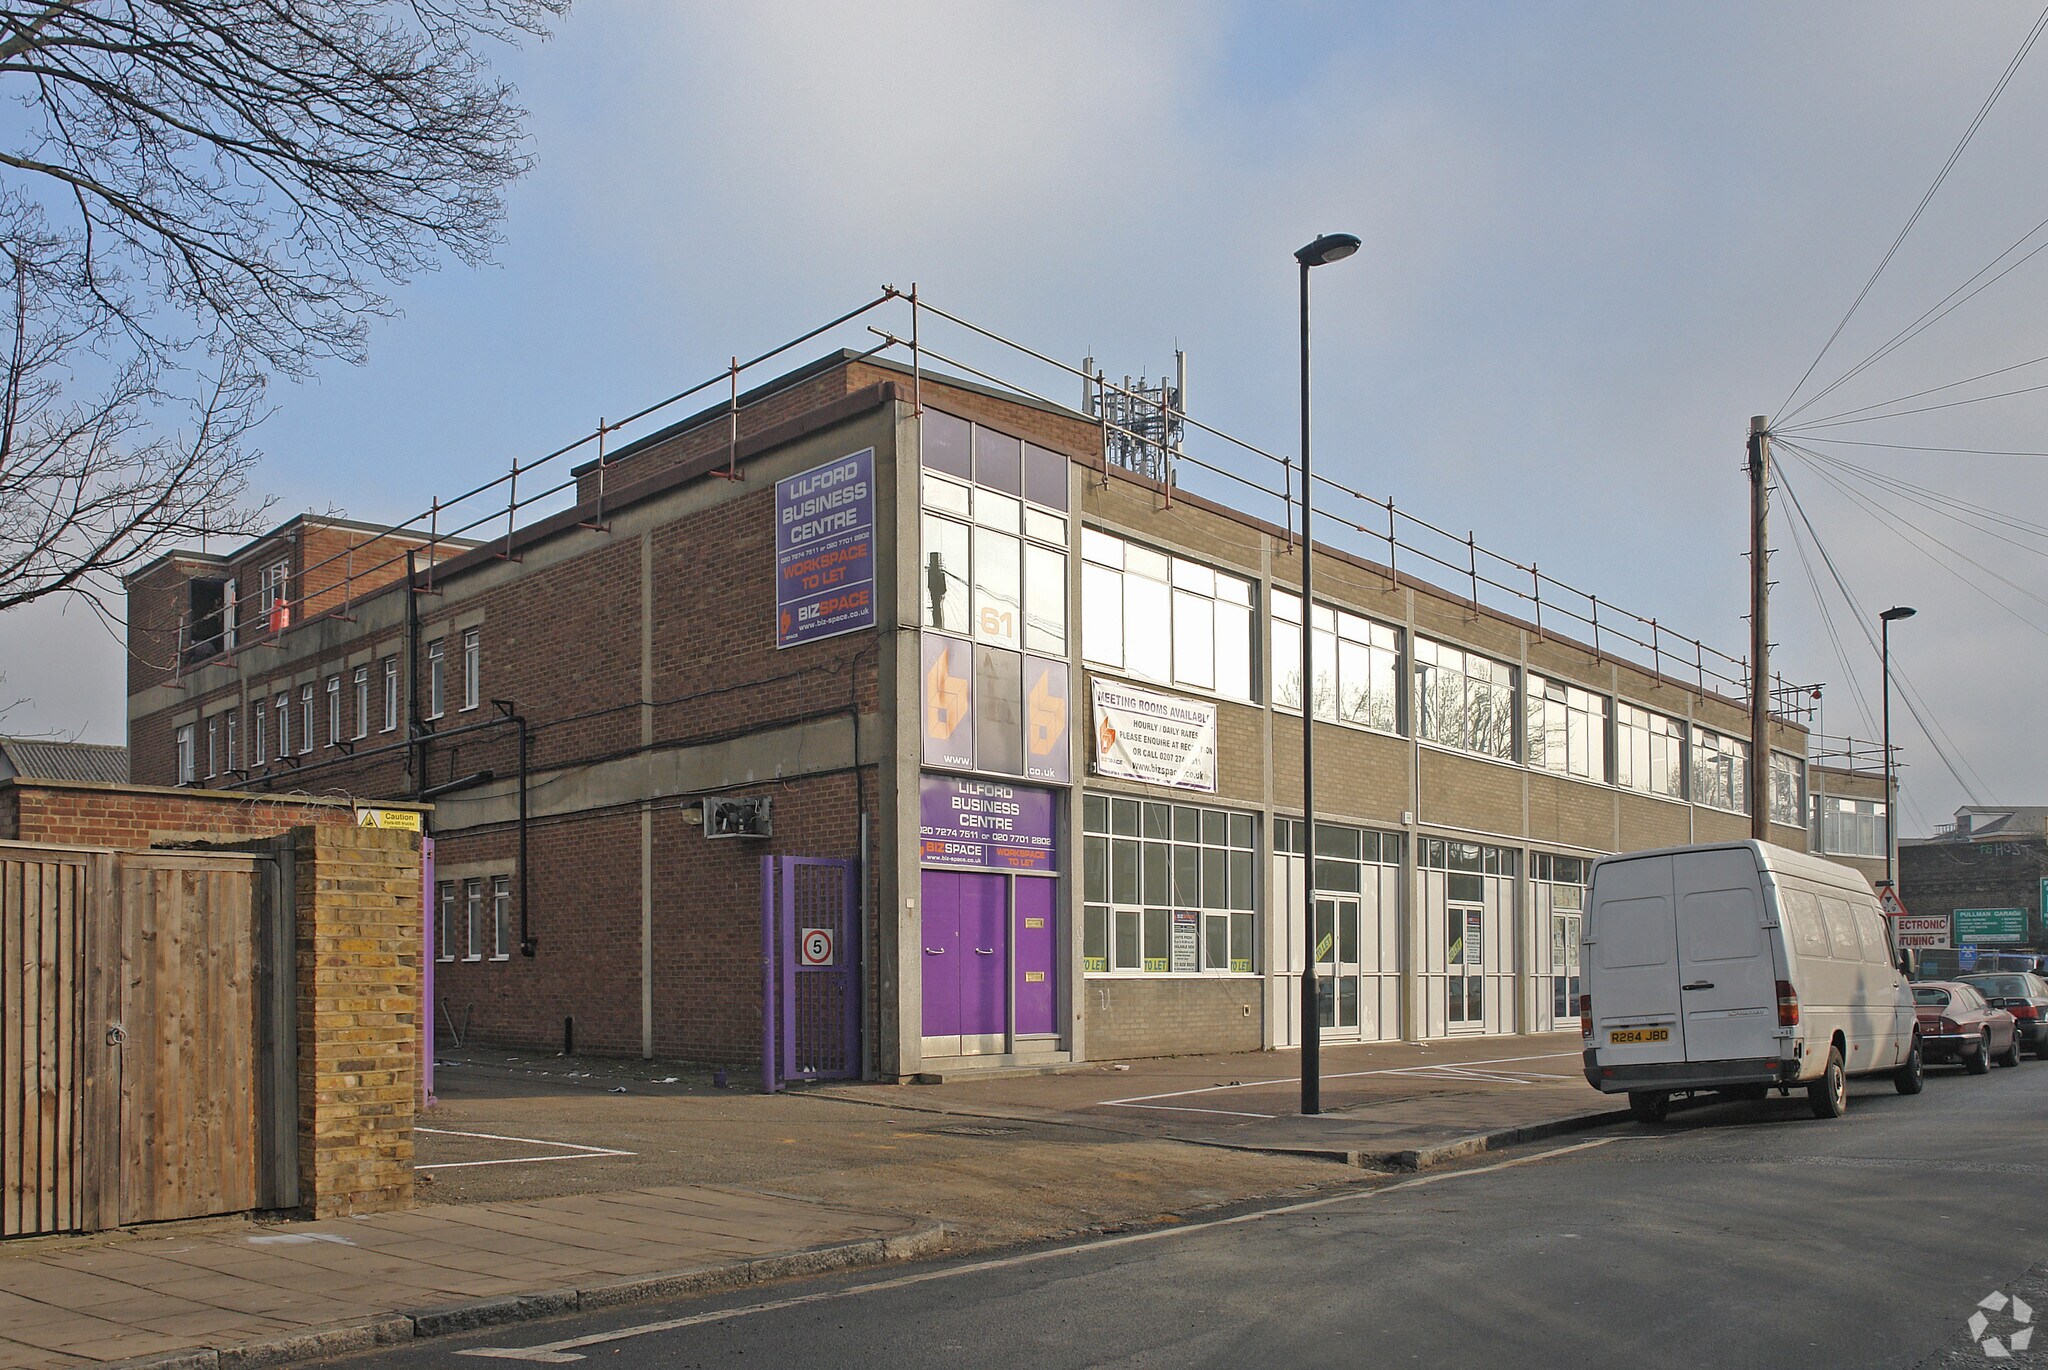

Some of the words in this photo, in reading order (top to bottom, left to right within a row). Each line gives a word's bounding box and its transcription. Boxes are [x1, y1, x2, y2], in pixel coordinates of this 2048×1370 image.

[790, 461, 858, 500] LILFORD
[783, 481, 867, 524] BUSINESS
[790, 508, 857, 544] CENTRE
[805, 547, 819, 555] 7511
[838, 537, 853, 546] 7701
[783, 544, 867, 579] WORKSPACE
[802, 574, 819, 590] TO
[822, 566, 846, 585] LET
[798, 590, 870, 621] BIZSPACE
[798, 607, 870, 631] www.biz-space.co.uk
[980, 606, 1013, 639] 61
[1097, 690, 1136, 709] MEETING
[1139, 700, 1168, 716] ROOMS
[1133, 720, 1158, 732] HOURLY
[1162, 726, 1179, 736] DAILY
[1180, 729, 1199, 740] RATES
[1120, 730, 1142, 743] PLEASE
[1143, 735, 1170, 748] ENQUIRE
[1171, 741, 1179, 750] AT
[1133, 747, 1141, 756] OR
[1142, 750, 1158, 759] CALL
[1159, 752, 1174, 762] 0207
[958, 781, 1013, 799] LILFORD
[952, 797, 1020, 815] BUSINESS
[385, 813, 414, 821] Caution
[959, 814, 1013, 830] CENTRE
[935, 827, 957, 837] 7274
[959, 830, 978, 839] 7511
[992, 833, 1008, 842] 020
[1010, 835, 1029, 843] 7701
[1031, 836, 1051, 845] 2802
[926, 841, 982, 856] BIZSPACE
[996, 847, 1046, 859] WORKSPACE
[926, 855, 981, 863] www.biz-space.co.uk
[1008, 857, 1019, 866] TO
[1021, 859, 1034, 867] LET
[813, 940, 822, 954] 5
[1092, 960, 1105, 971] LET
[1144, 960, 1152, 971] TO
[1154, 960, 1166, 971] LET
[1239, 961, 1249, 971] LET
[1611, 1030, 1642, 1043] R284
[1645, 1029, 1669, 1041] JBD
